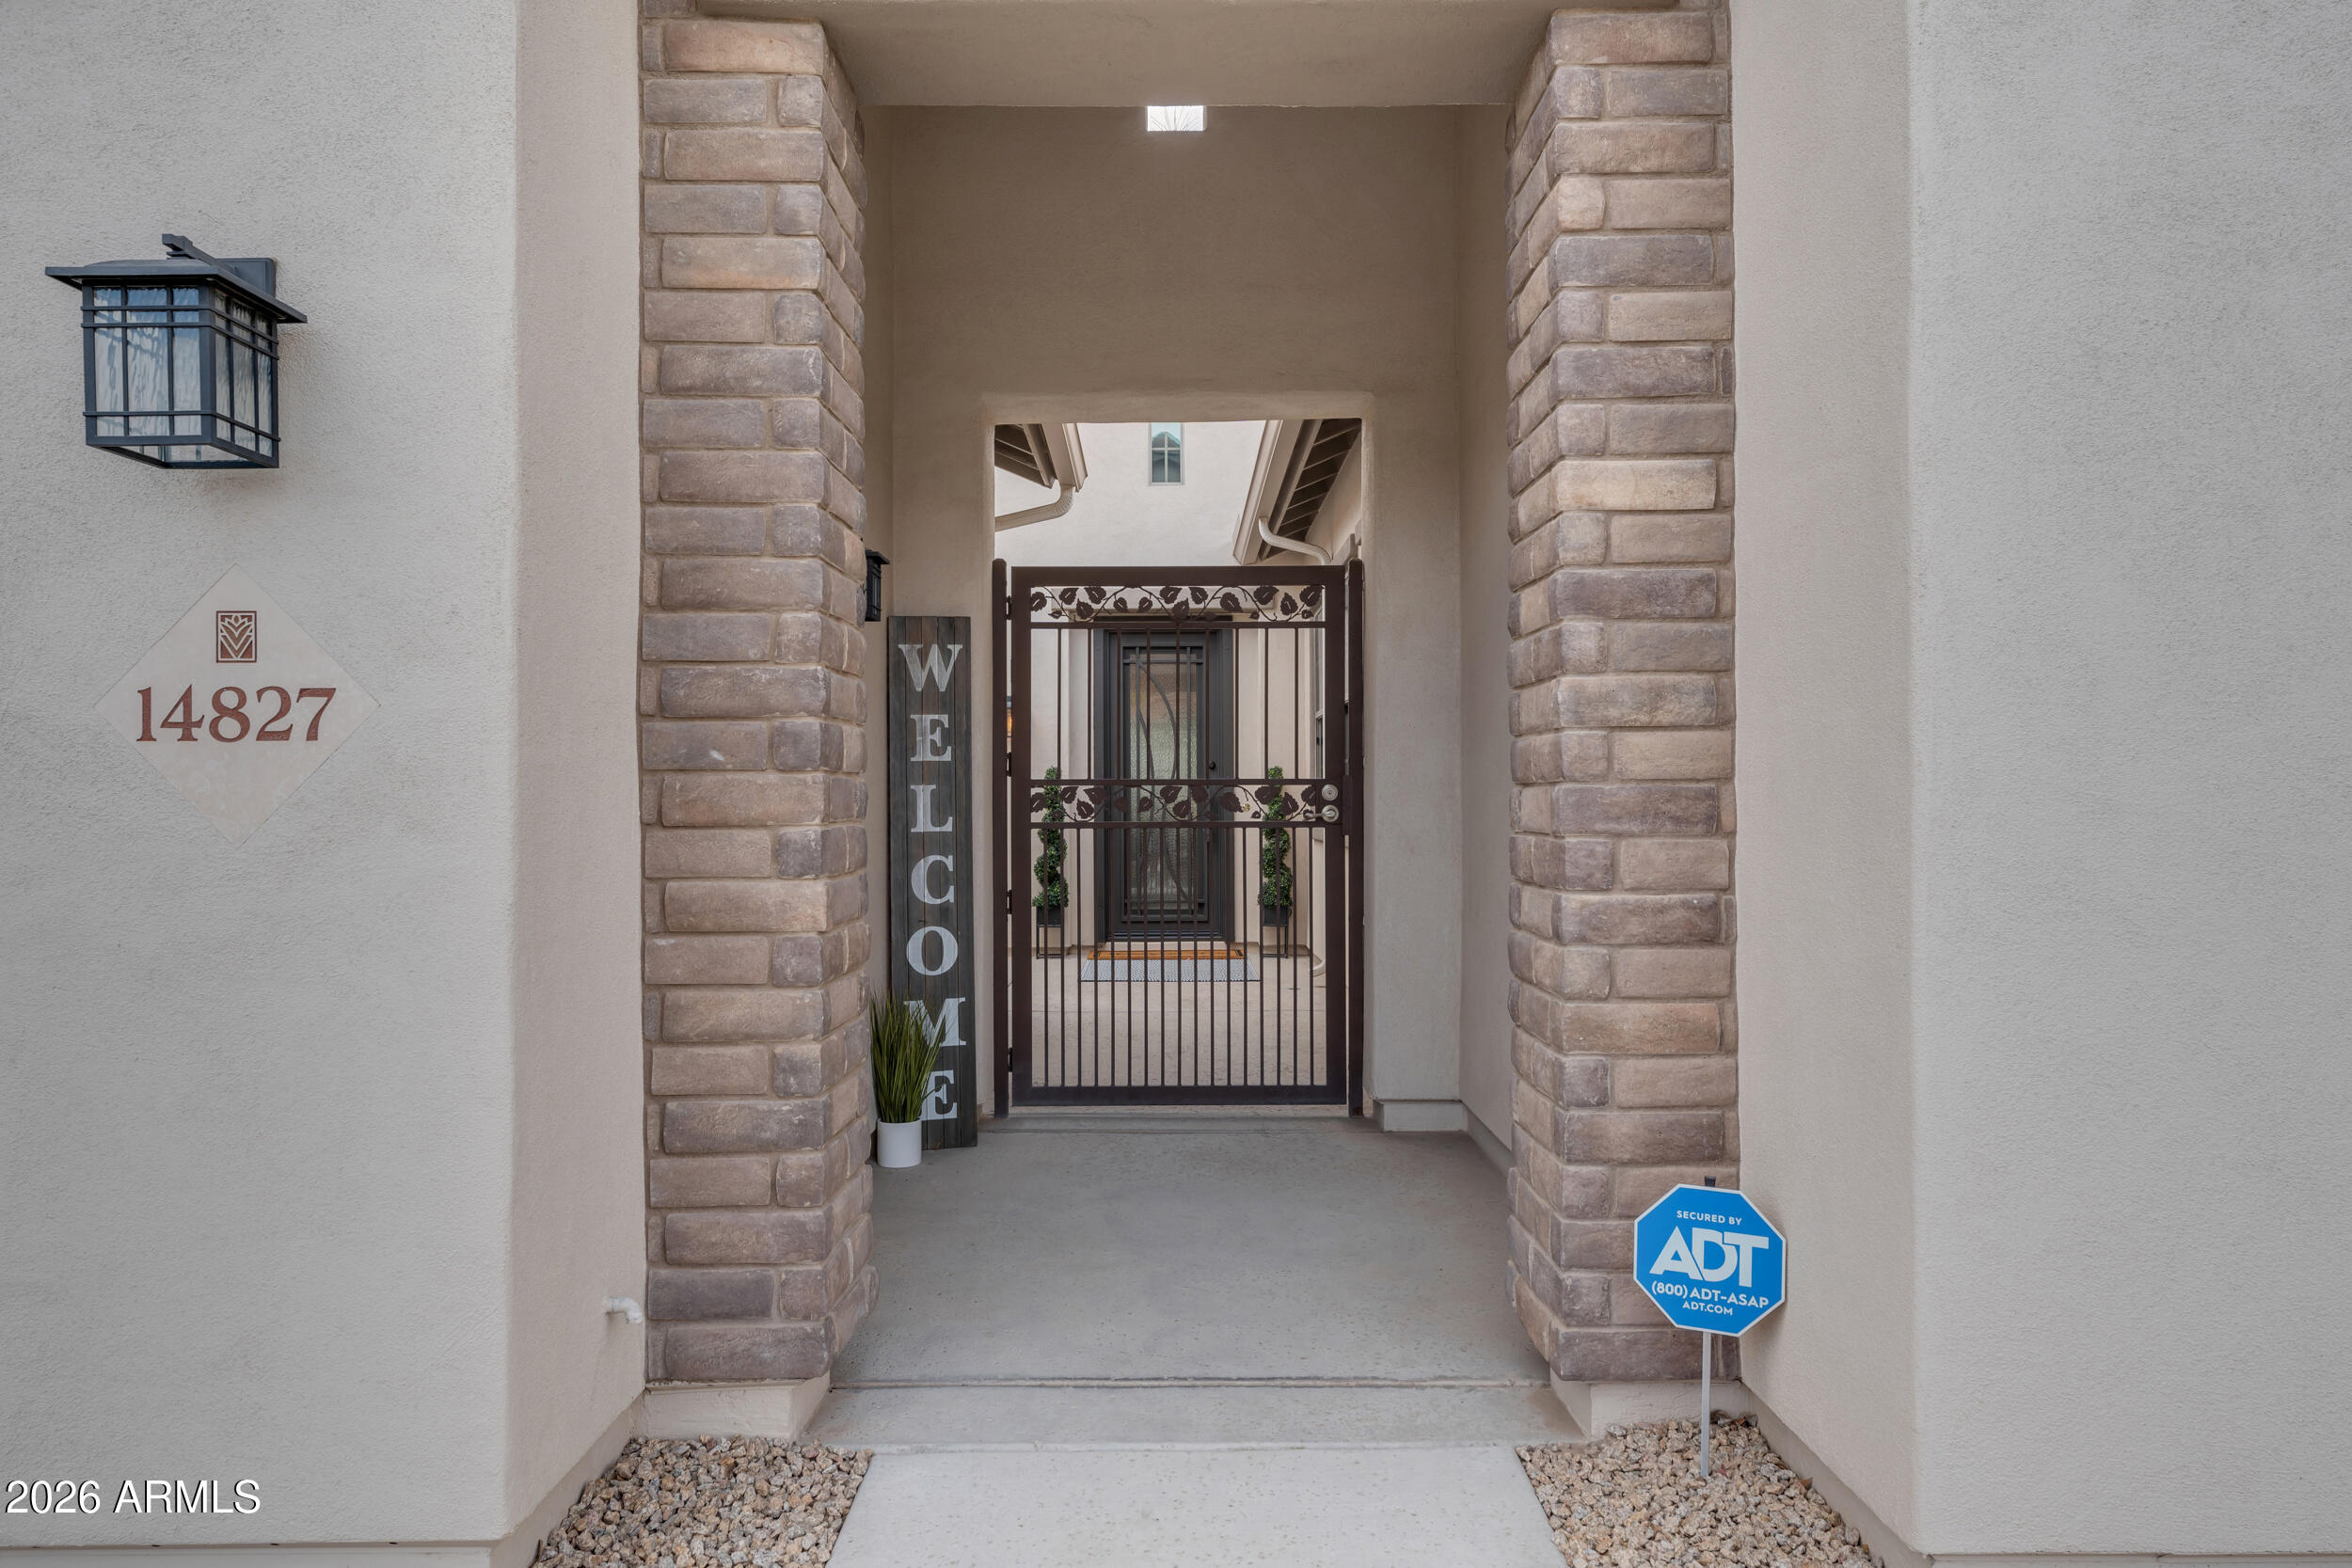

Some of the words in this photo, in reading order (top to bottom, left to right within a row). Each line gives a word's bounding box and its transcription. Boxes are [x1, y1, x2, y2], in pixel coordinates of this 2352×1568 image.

[136, 684, 337, 742] 14827
[898, 643, 966, 1120] WELCOME
[1677, 1210, 1725, 1224] SECURED
[1728, 1217, 1742, 1226] BY
[1649, 1226, 1770, 1288] ADT
[1651, 1280, 1689, 1299] (800)
[1690, 1287, 1769, 1308] ADT-ASAP
[1682, 1301, 1733, 1316] ADT.COM
